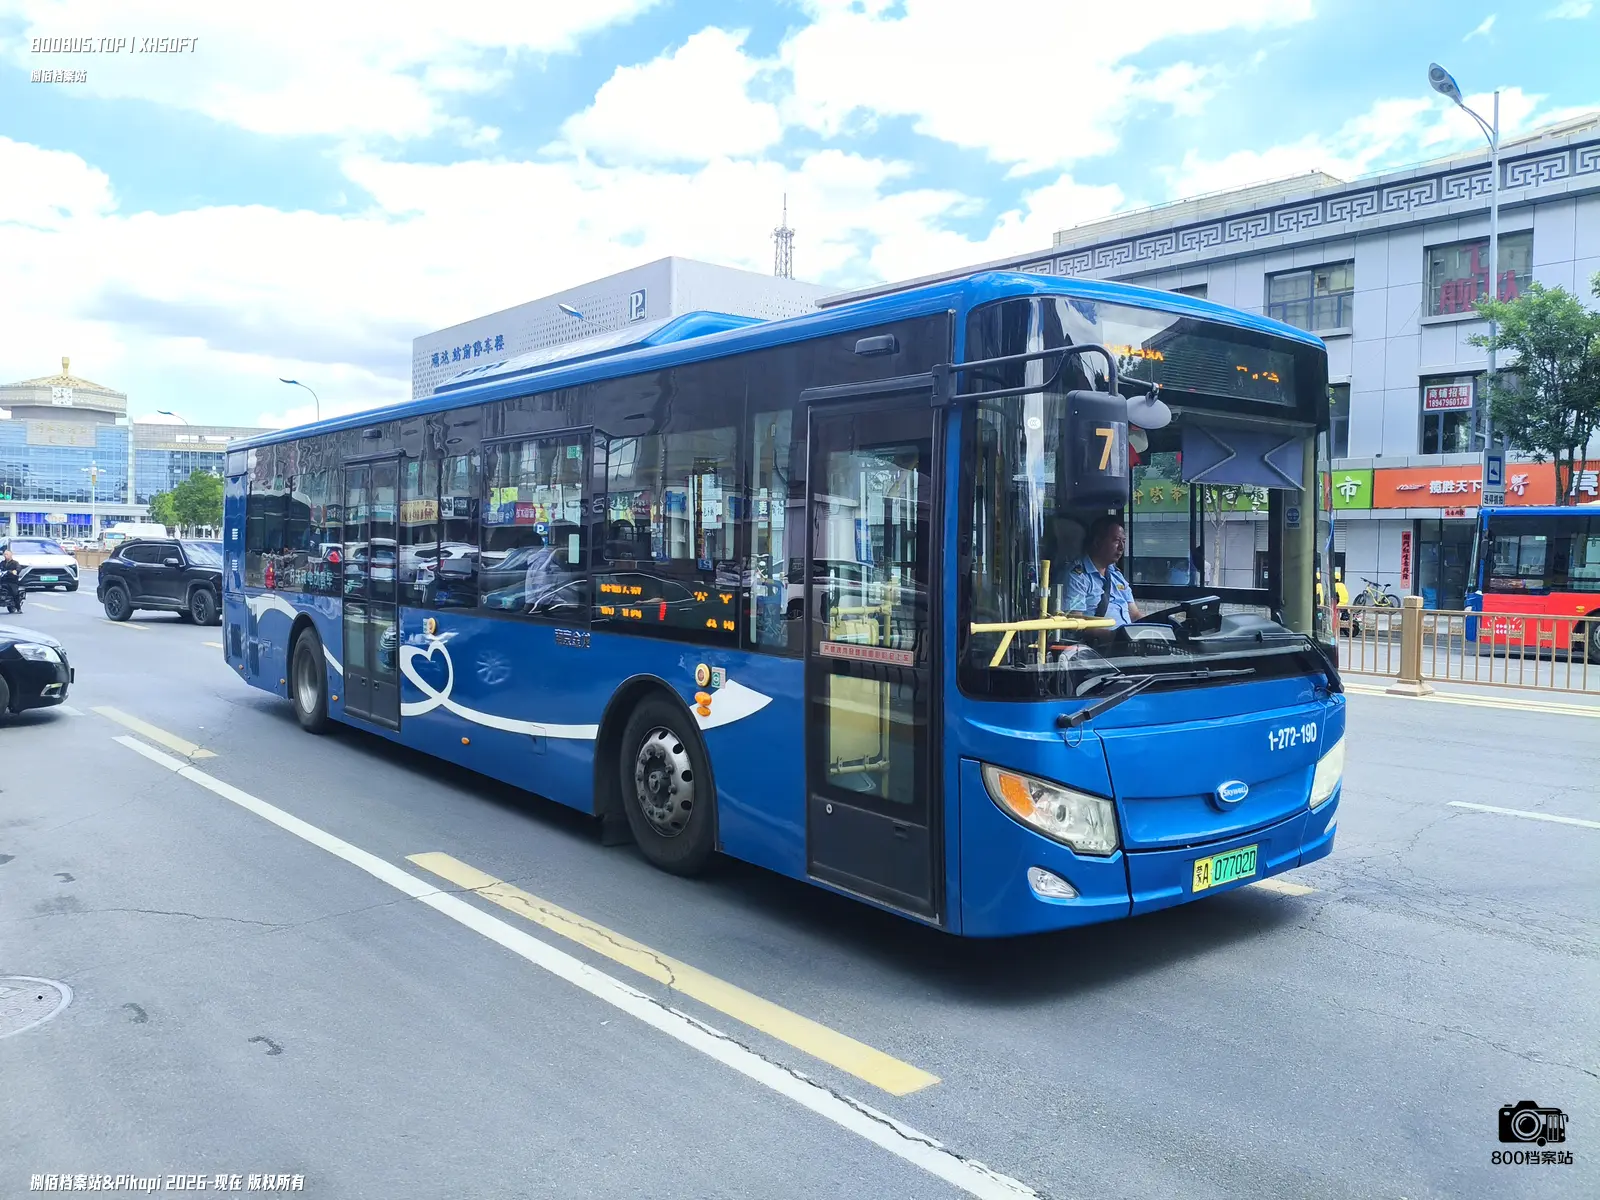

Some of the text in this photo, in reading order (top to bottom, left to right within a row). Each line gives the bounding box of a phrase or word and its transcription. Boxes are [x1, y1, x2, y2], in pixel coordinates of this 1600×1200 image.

[1428, 386, 1468, 399] 商铺招租
[1095, 427, 1115, 471] 7
[1335, 475, 1362, 503] 市
[1429, 479, 1482, 494] 揽胜天下
[1268, 722, 1317, 751] 1-272-190
